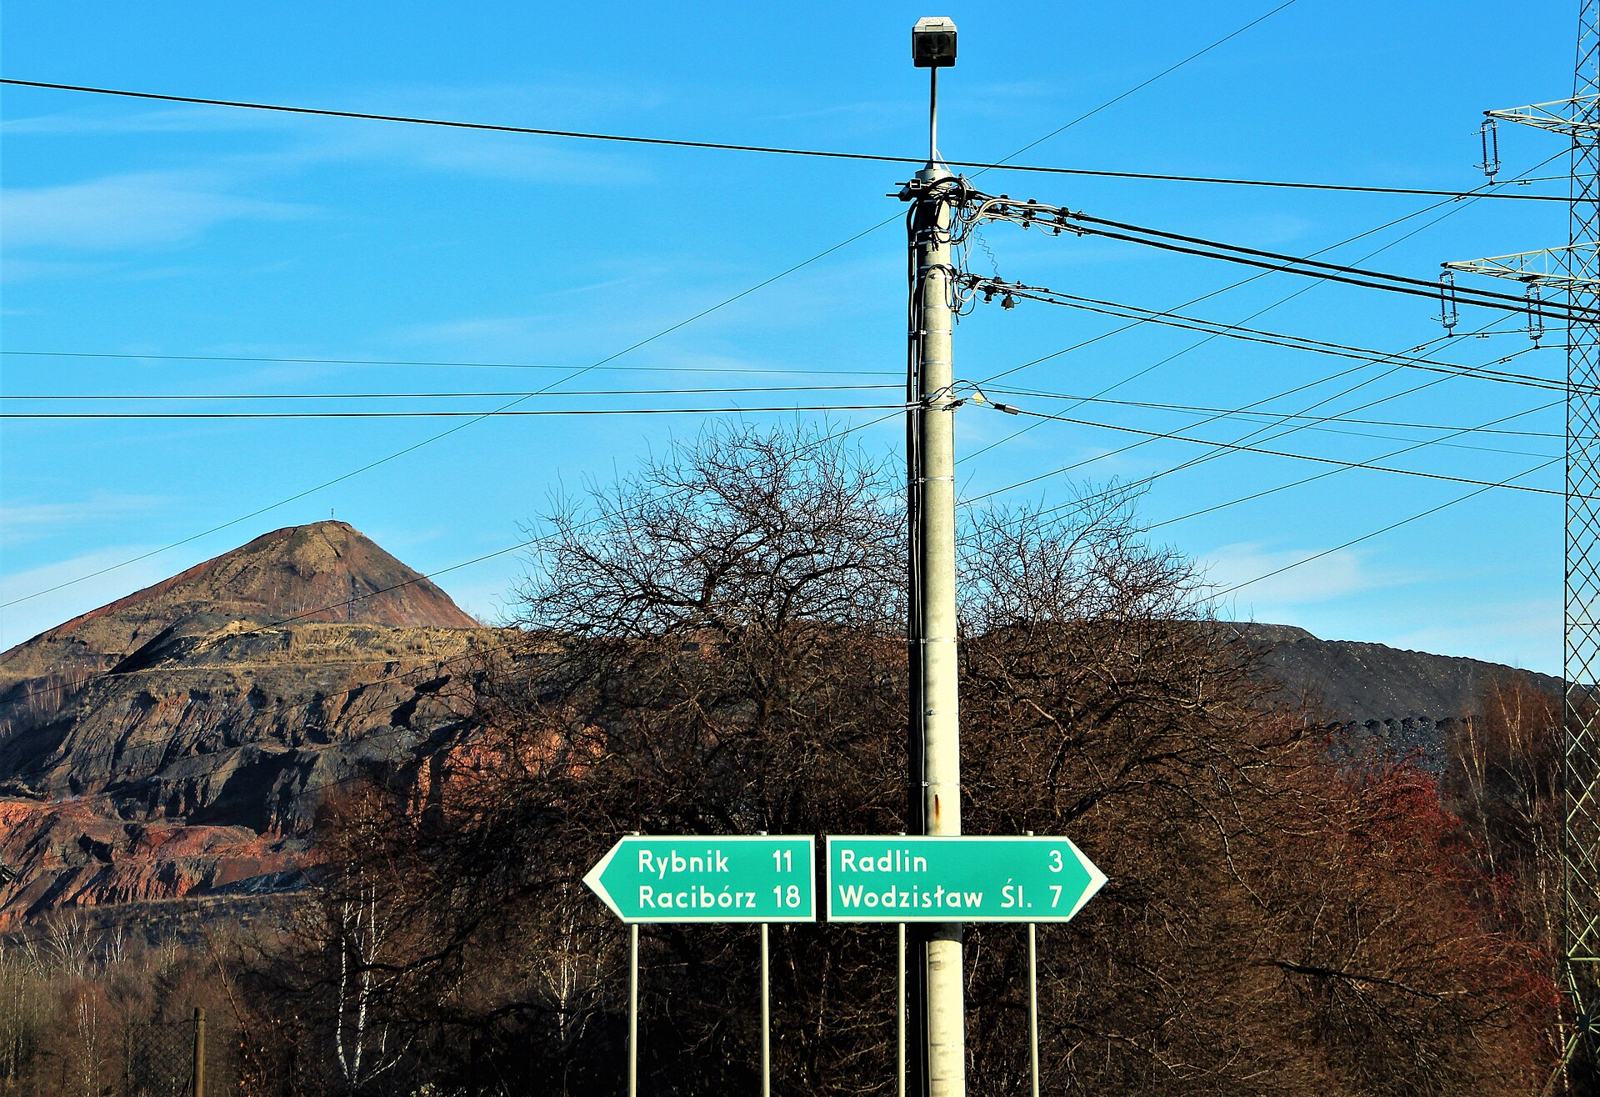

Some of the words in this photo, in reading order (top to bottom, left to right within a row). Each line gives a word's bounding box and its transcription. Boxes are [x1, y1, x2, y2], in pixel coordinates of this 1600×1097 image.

[638, 849, 729, 879] Rybnik
[773, 849, 792, 872] 11
[840, 849, 927, 873] Radlin
[1049, 849, 1064, 873] 3
[639, 884, 756, 909] Racibórz
[774, 884, 801, 908] 18
[838, 884, 983, 909] Wodzisław
[1000, 878, 1031, 909] Śl.
[1050, 885, 1063, 908] 7
